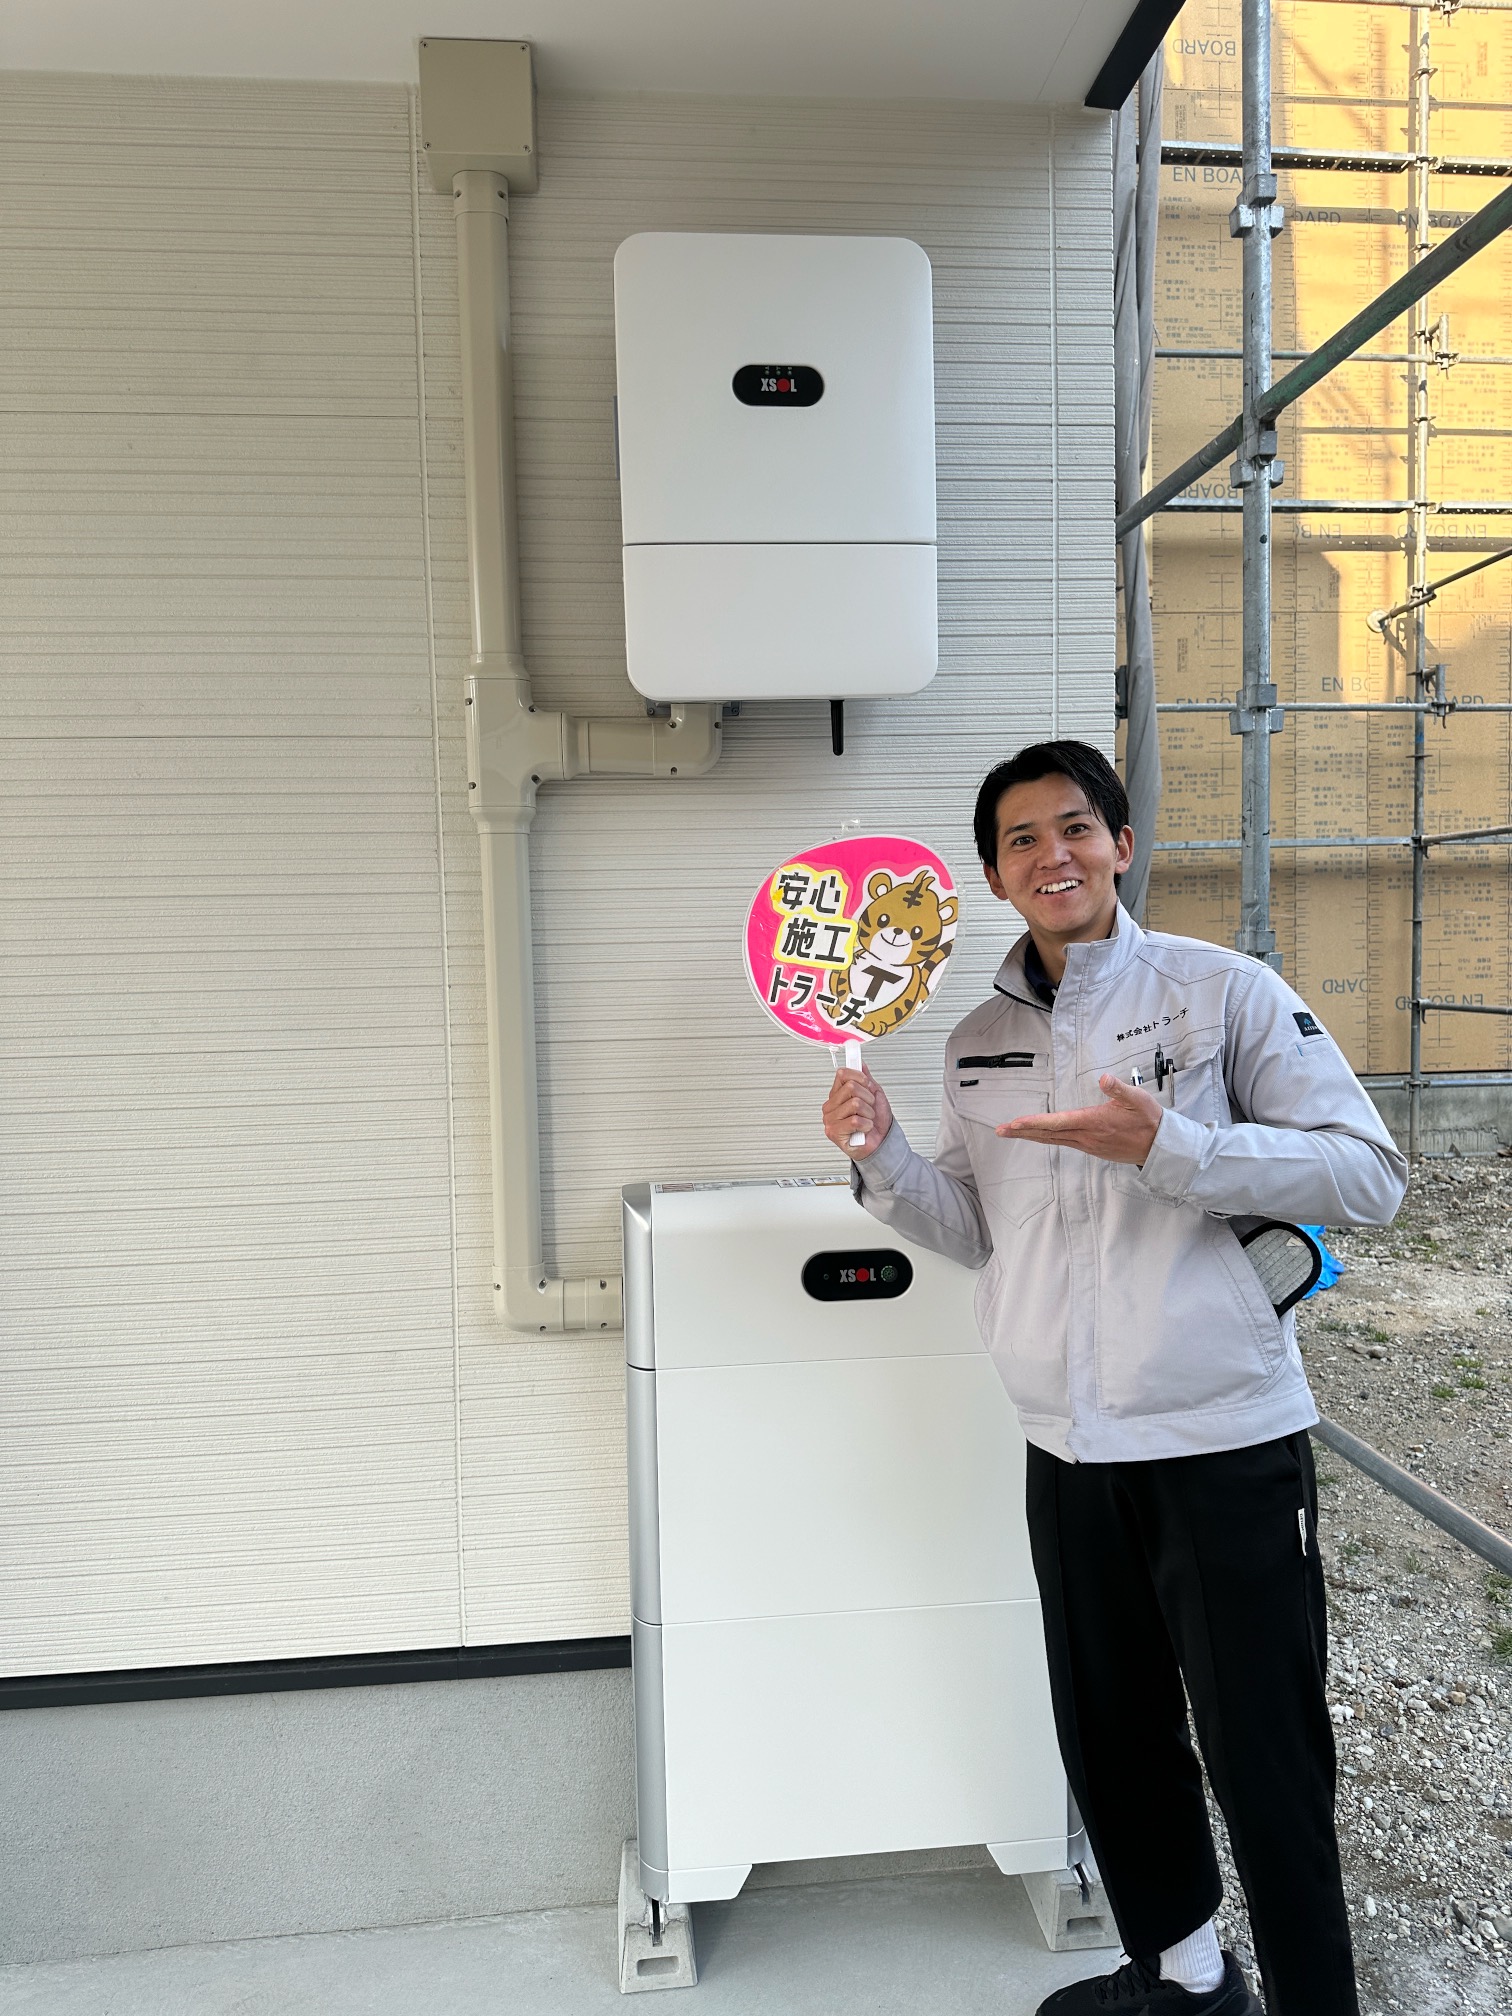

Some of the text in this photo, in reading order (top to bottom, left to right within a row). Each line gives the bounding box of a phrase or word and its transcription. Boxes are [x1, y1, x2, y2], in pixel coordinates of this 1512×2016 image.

[1172, 38, 1236, 57] BOARD
[1173, 166, 1243, 184] EN BOA
[1294, 210, 1341, 227] OARD
[1428, 214, 1473, 229] BOA
[761, 377, 798, 393] XSOL
[1397, 523, 1458, 540] BORD
[1321, 676, 1344, 692] EN
[778, 871, 842, 915] 安心
[781, 917, 853, 965] 施工
[1322, 977, 1369, 994] OARD
[769, 966, 871, 1027] トラーチ
[1116, 1006, 1190, 1043] 株式会社トラーチ
[839, 1267, 877, 1283] XSOL
